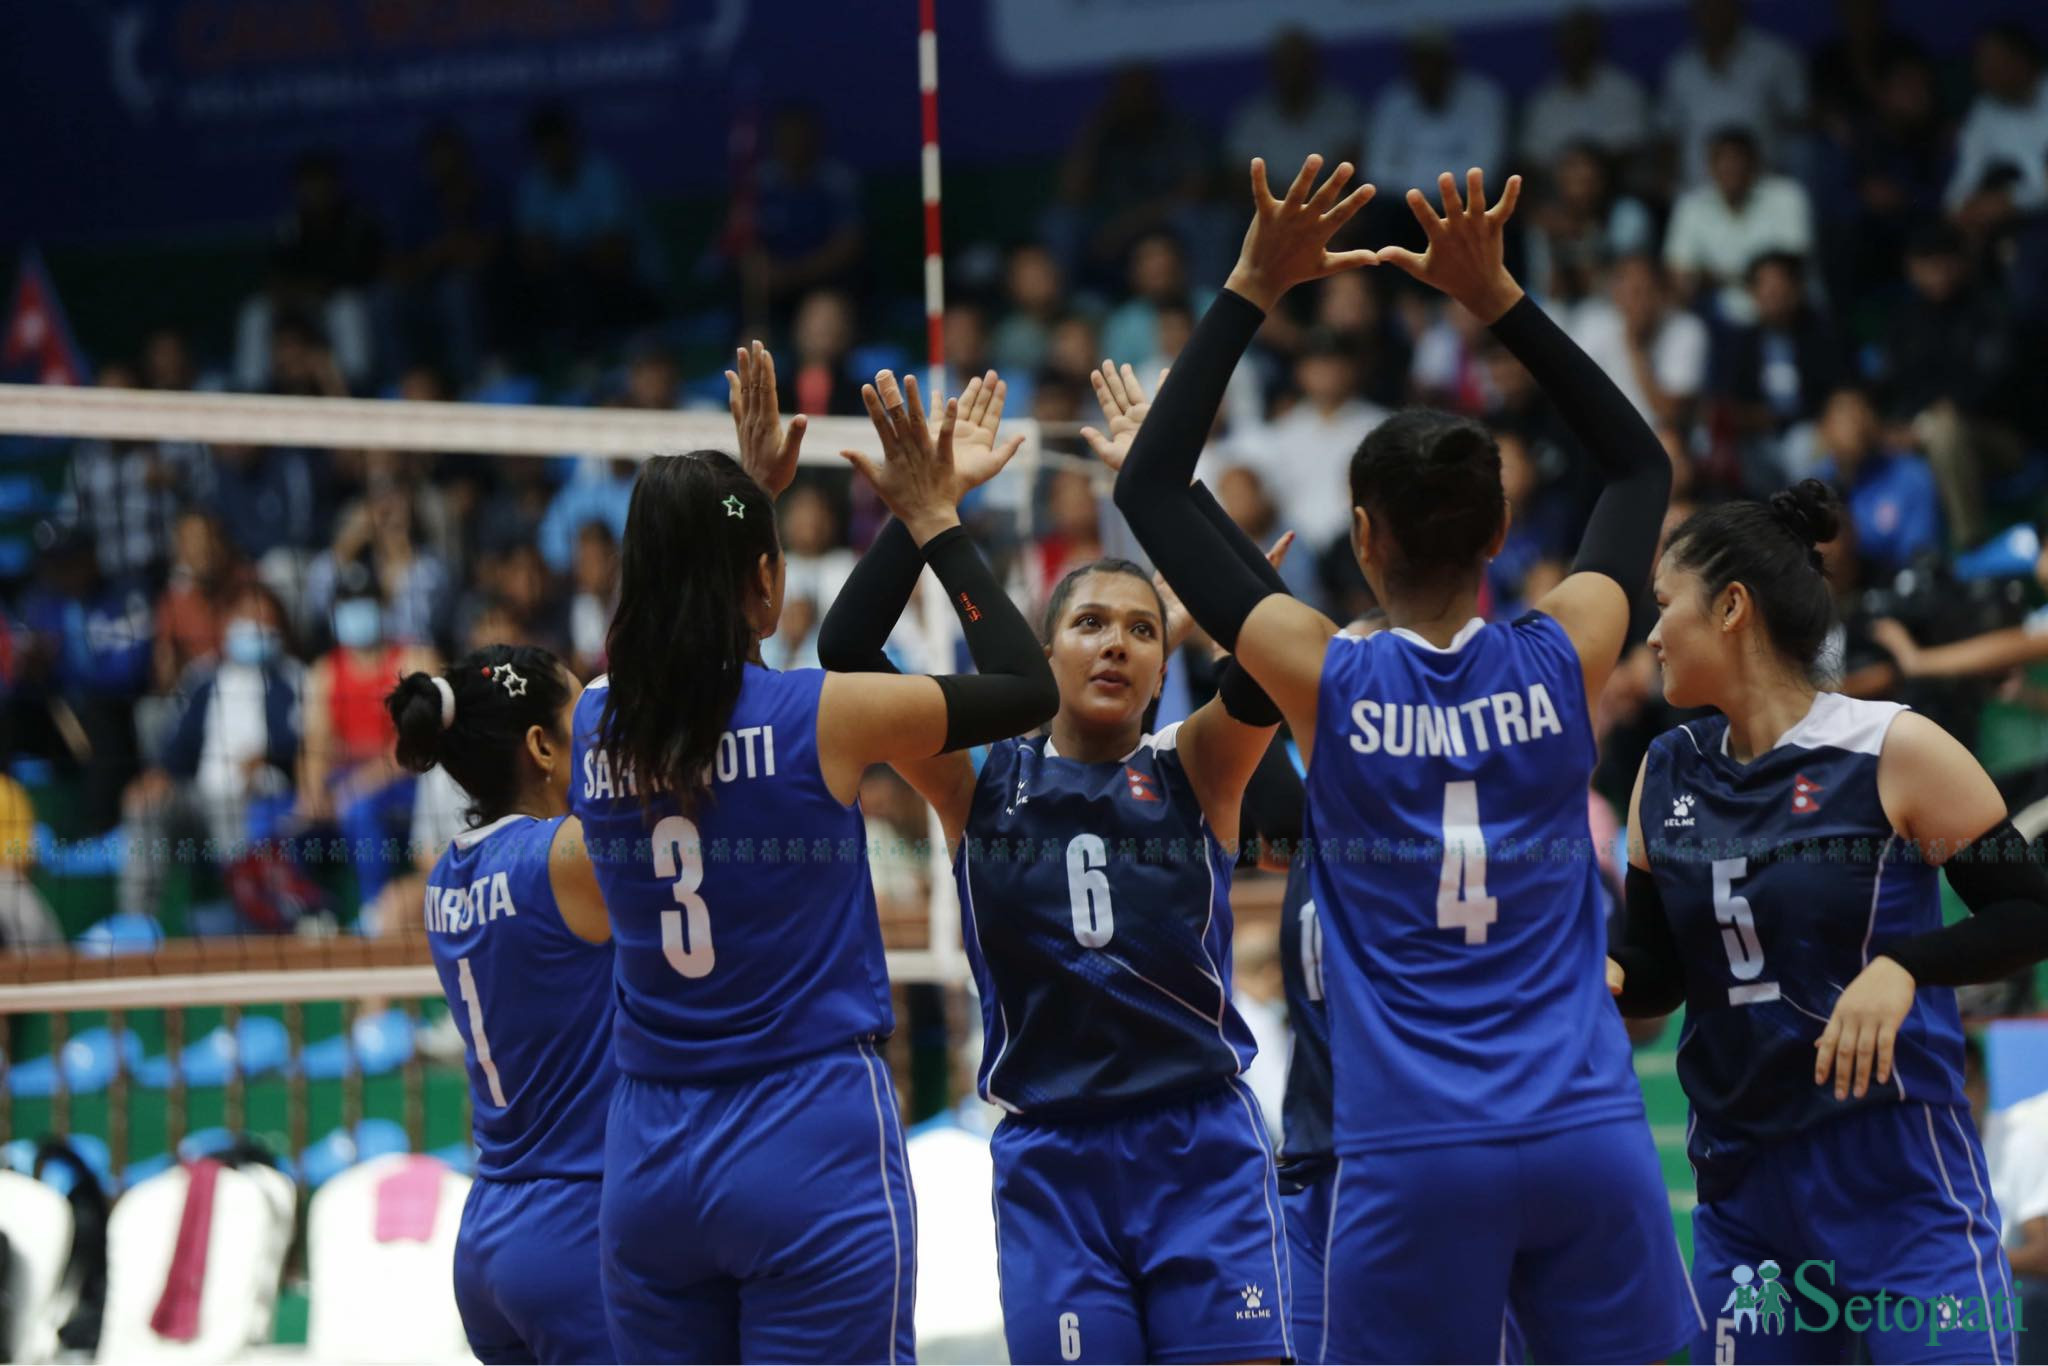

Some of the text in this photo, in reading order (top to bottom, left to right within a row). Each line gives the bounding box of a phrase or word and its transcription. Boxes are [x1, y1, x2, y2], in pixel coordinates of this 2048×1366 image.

[1349, 684, 1562, 757] SUMITRA
[652, 817, 716, 978] 3
[1066, 833, 1114, 949] 6
[1437, 780, 1498, 945] 4
[1713, 857, 1764, 981] 5
[457, 958, 507, 1107] 1
[1058, 1312, 1082, 1361] 6
[1235, 1310, 1271, 1319] KELME
[1715, 1318, 1736, 1365] 5
